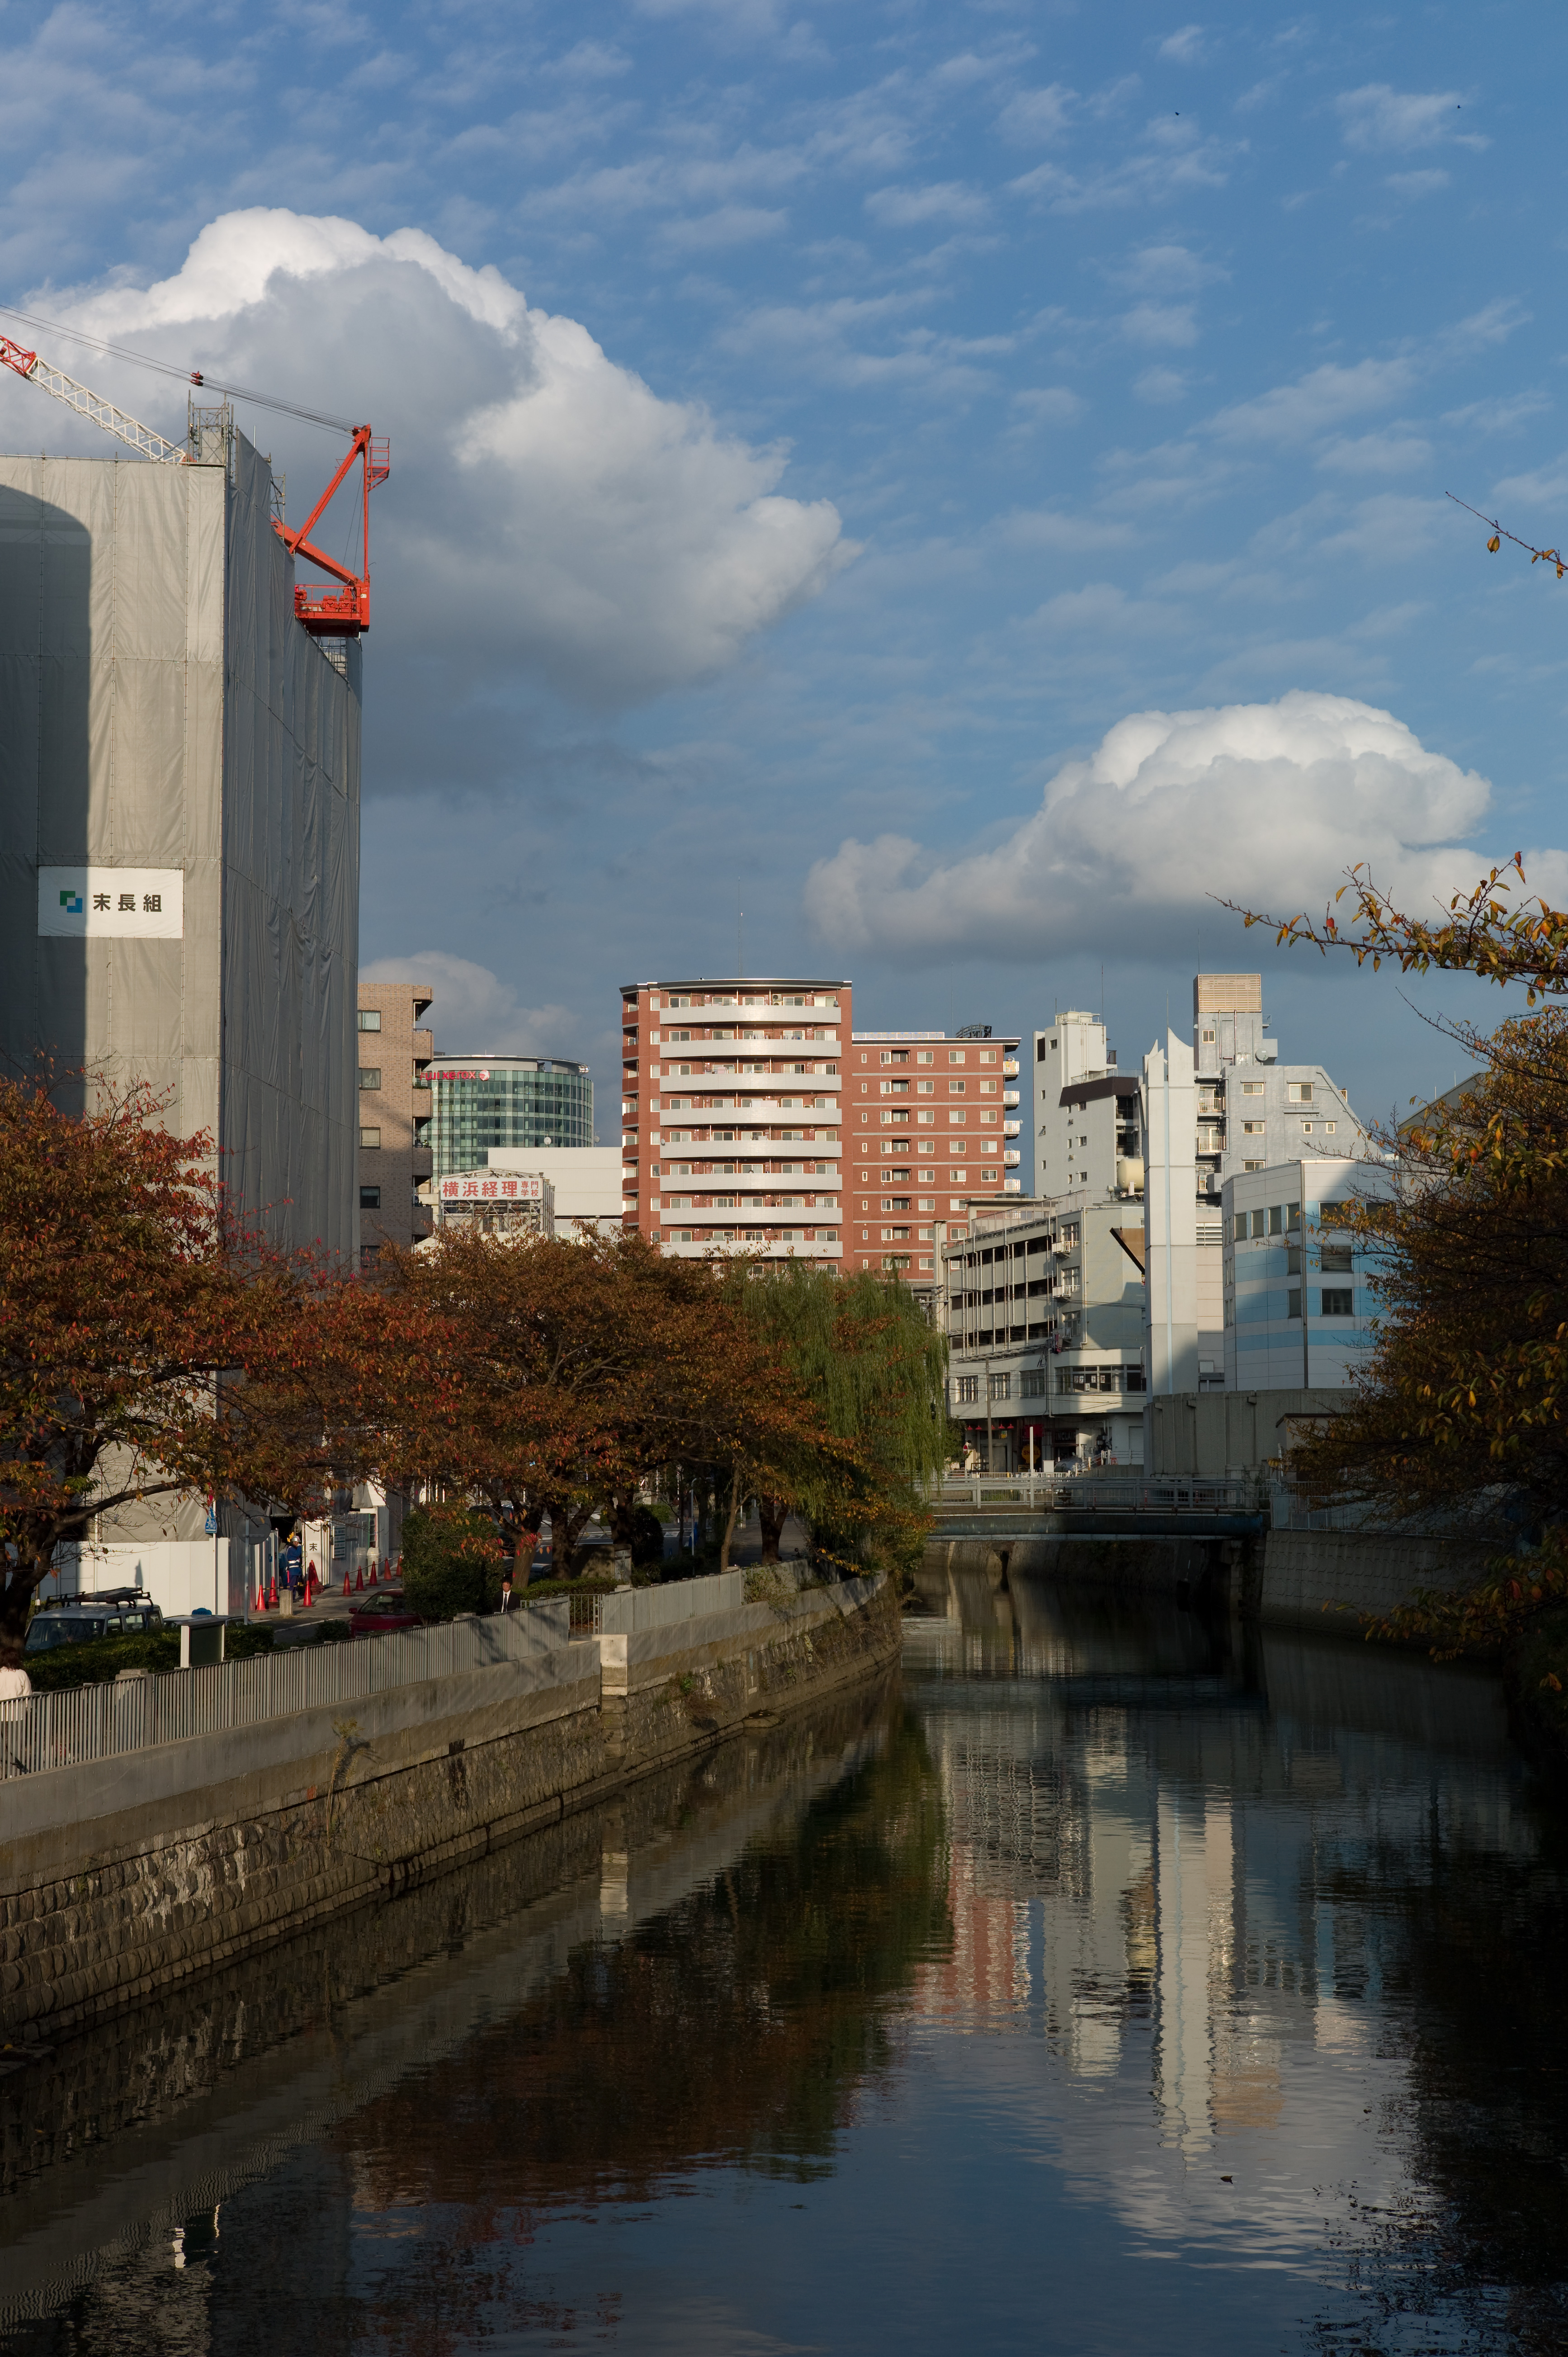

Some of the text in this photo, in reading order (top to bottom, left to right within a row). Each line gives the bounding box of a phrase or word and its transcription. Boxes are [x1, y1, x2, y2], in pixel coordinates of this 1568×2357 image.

[93, 893, 162, 912] 末長組
[442, 1071, 476, 1079] xerox
[442, 1181, 518, 1197] 横浜経理
[521, 1181, 538, 1189] 専門
[309, 1543, 317, 1551] 末
